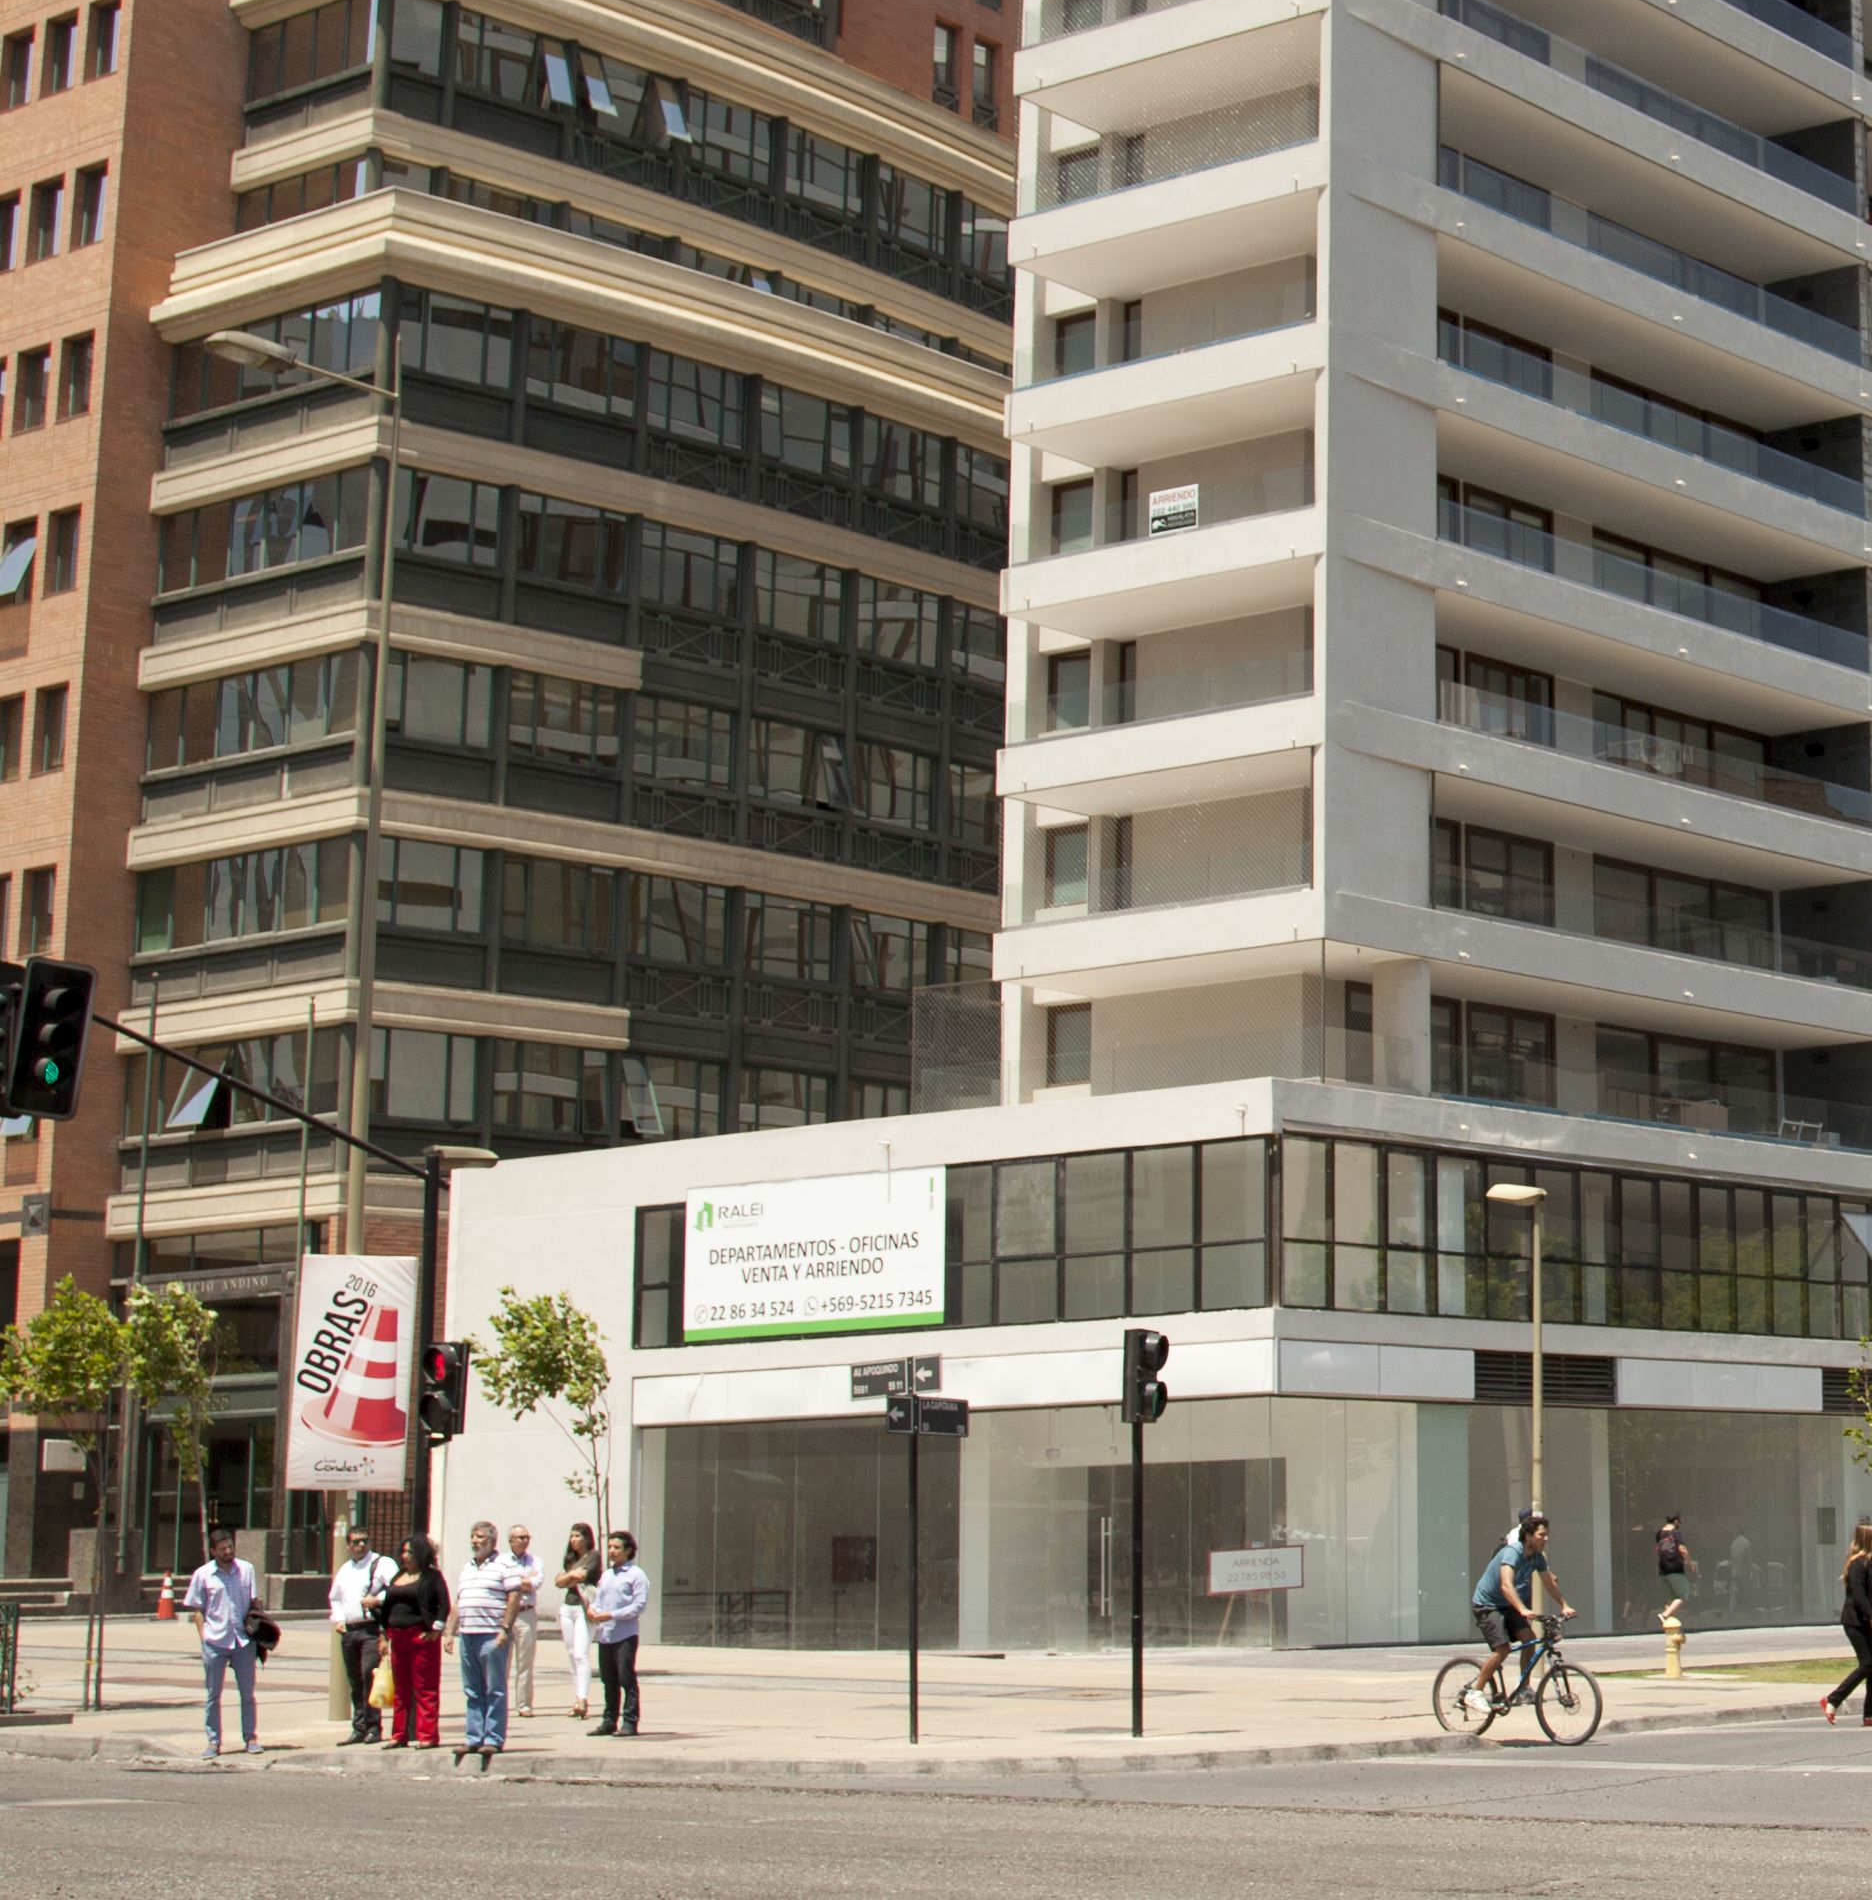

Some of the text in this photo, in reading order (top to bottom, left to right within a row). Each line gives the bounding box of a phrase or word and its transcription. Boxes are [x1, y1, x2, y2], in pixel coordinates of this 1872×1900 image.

[1152, 489, 1196, 505] ARRIENDO
[718, 1202, 764, 1219] RALEI
[709, 1239, 836, 1265] DEPARTAMENTOS
[850, 1231, 919, 1253] OFICINAS
[742, 1257, 884, 1284] VENTA Y ARRIENDO
[223, 1276, 268, 1291] ANDINO
[345, 1274, 378, 1298] 2016
[710, 1290, 932, 1321] 22 86 34 524 +569-5215 7345
[297, 1290, 368, 1393] OBRAS
[863, 1363, 899, 1376] APOQUINDO
[314, 1460, 358, 1472] Condes
